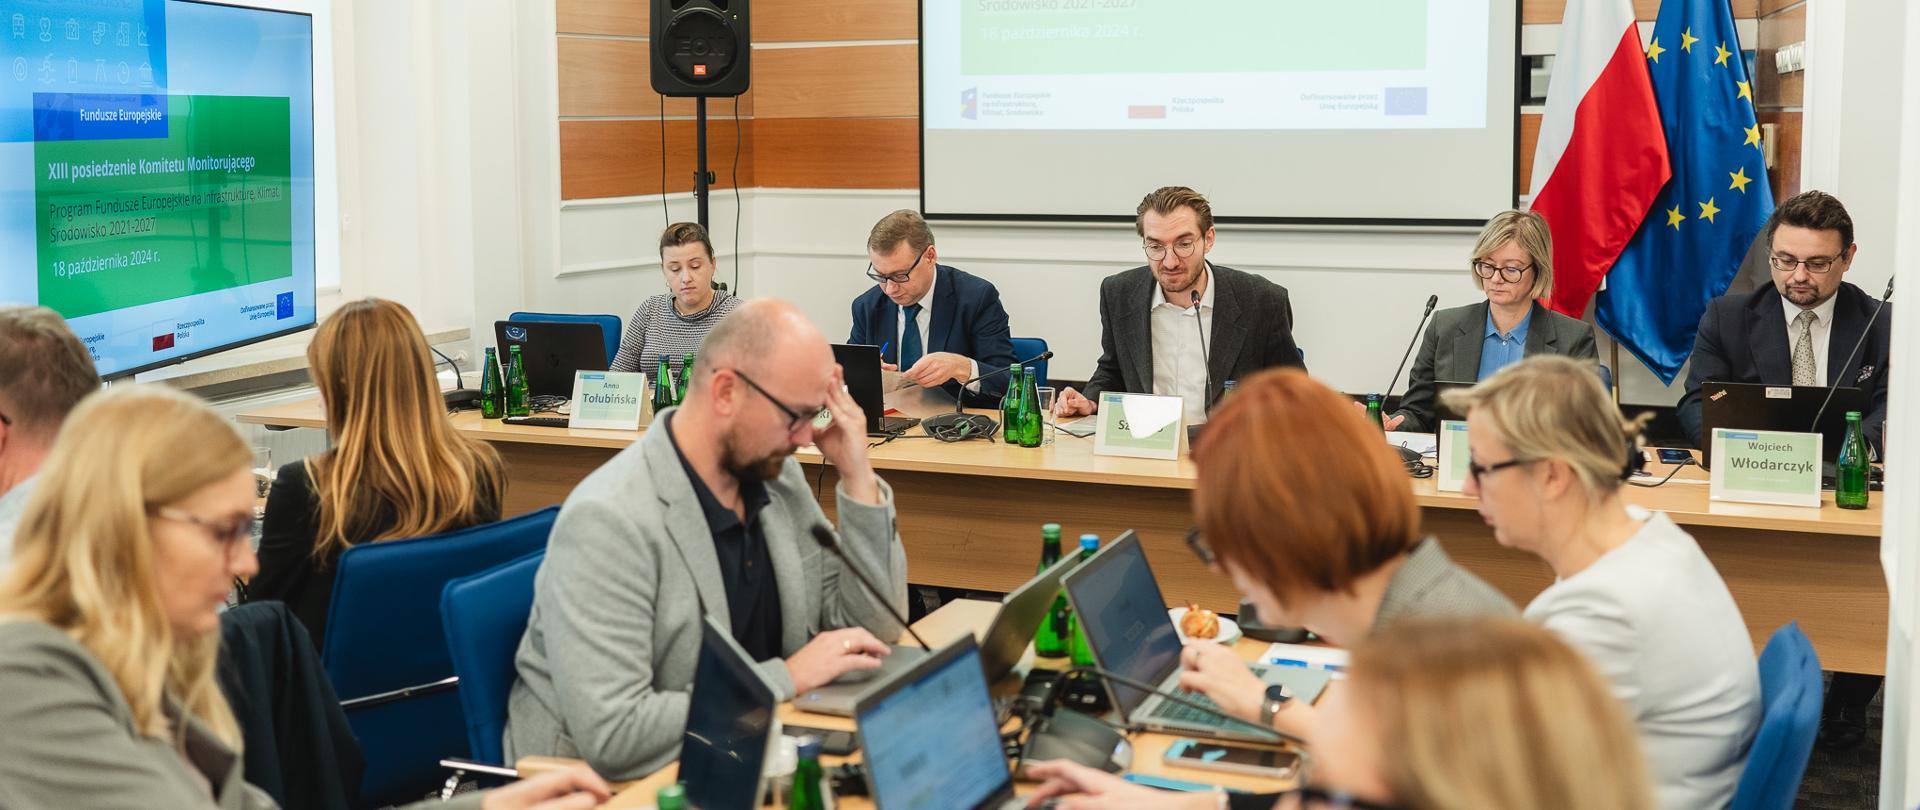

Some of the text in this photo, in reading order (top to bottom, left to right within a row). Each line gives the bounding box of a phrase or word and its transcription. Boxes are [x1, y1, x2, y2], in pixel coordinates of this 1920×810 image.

[1095, 24, 1129, 39] 2024
[80, 108, 162, 124] Fundusze Europejskie
[48, 154, 255, 183] XIII posiedzenie Komitetu Monitorującego
[50, 202, 93, 222] Program
[95, 198, 139, 214] Fundusze
[141, 194, 190, 211] Europejskie
[192, 195, 201, 204] na
[50, 217, 156, 243] Środowisko 2021-2027
[53, 250, 161, 279] 18 października 2024 r.
[583, 393, 637, 405] Tołubińska
[1748, 441, 1793, 453] Wojciech
[1731, 457, 1814, 474] Włodarczyk
